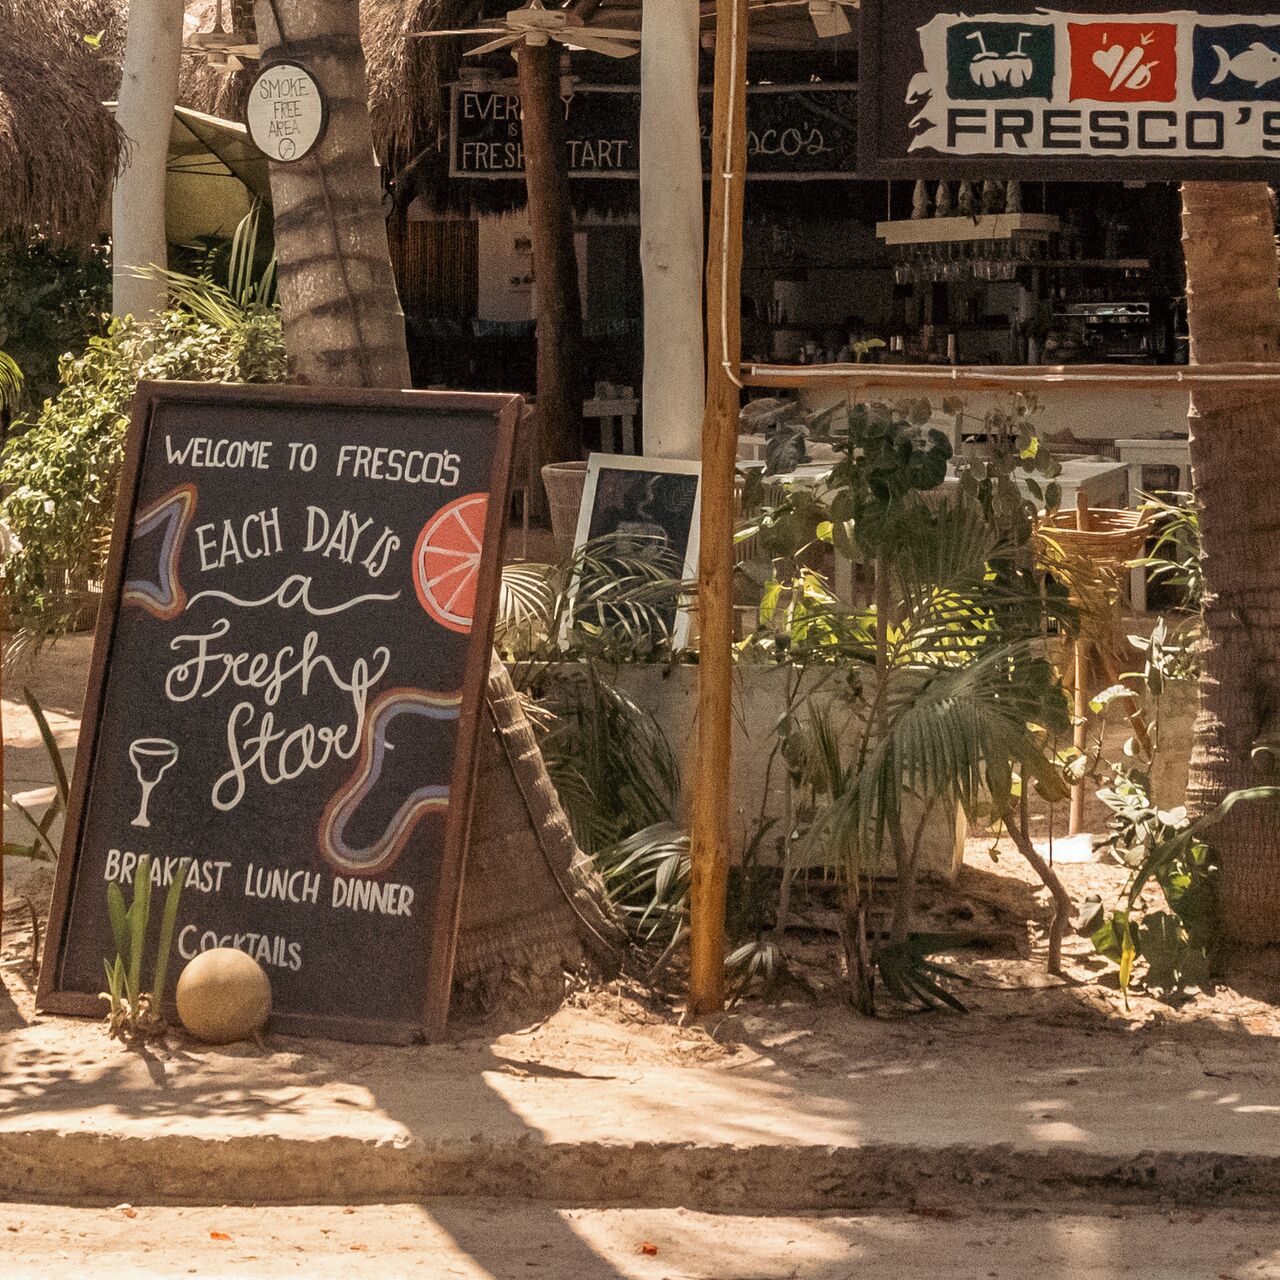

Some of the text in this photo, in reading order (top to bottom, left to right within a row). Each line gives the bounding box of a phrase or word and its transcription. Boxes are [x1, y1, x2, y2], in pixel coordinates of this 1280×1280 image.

[260, 77, 309, 99] SMOKE
[464, 93, 520, 120] EVER
[268, 120, 300, 137] AREA
[274, 100, 302, 119] FREE
[566, 140, 629, 168] TART
[165, 435, 461, 486] WELCOME TO FRESCO'S
[195, 505, 401, 577] EACH DAY IS
[165, 617, 352, 707] Fresh
[211, 656, 373, 812] Start
[104, 849, 415, 916] BRAKAST LUNCH DINNER
